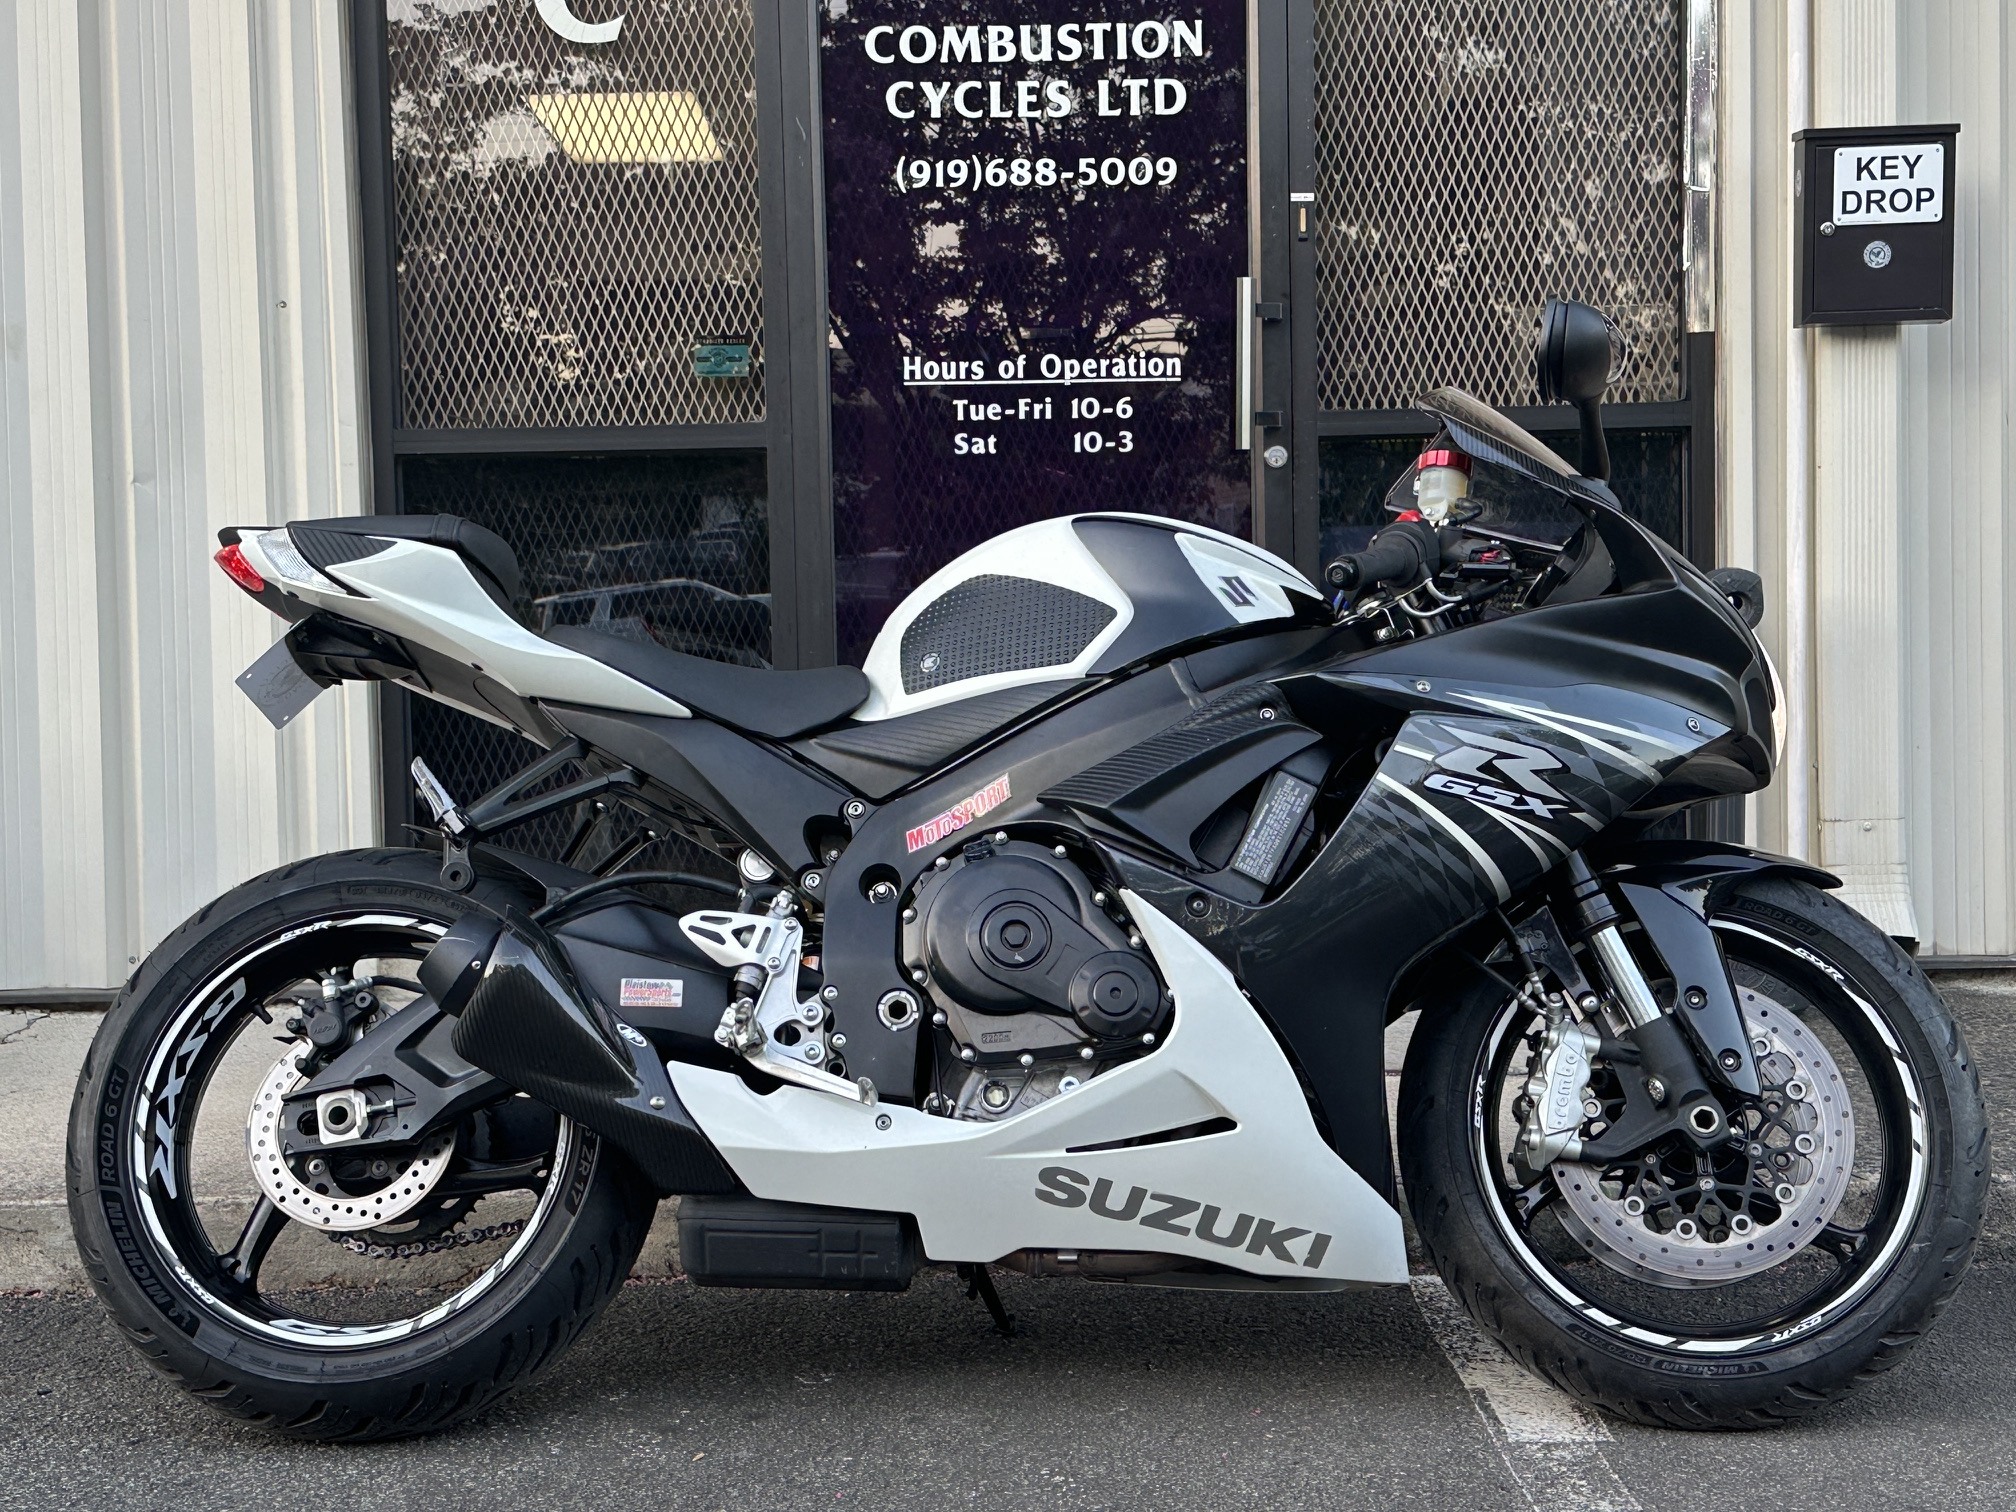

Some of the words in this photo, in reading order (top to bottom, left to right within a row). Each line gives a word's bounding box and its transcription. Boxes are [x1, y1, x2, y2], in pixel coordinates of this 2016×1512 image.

[864, 20, 1203, 64] COMBUSTION
[885, 80, 1072, 119] CYCLES
[1097, 78, 1187, 117] LTD
[896, 155, 1178, 193] (919)688-5009
[1856, 154, 1923, 181] KEY
[1841, 187, 1935, 215] DROP
[902, 356, 984, 381] Hours
[999, 354, 1026, 380] of
[1040, 352, 1182, 385] Operation
[953, 397, 1052, 421] Tue-Fri
[1071, 397, 1134, 420] 10-6
[954, 433, 997, 455] Sat
[1073, 431, 1134, 453] 10-3
[1423, 773, 1569, 819] GSX
[108, 1069, 124, 1099] GT
[104, 1102, 118, 1118] 6
[101, 1122, 116, 1182] ROAD
[579, 1145, 594, 1176] ZR
[571, 1182, 584, 1206] 17
[1035, 1166, 1332, 1269] SUZUKI
[106, 1201, 172, 1304] MICHELIN
[1661, 1361, 1739, 1375] MICHELIN
